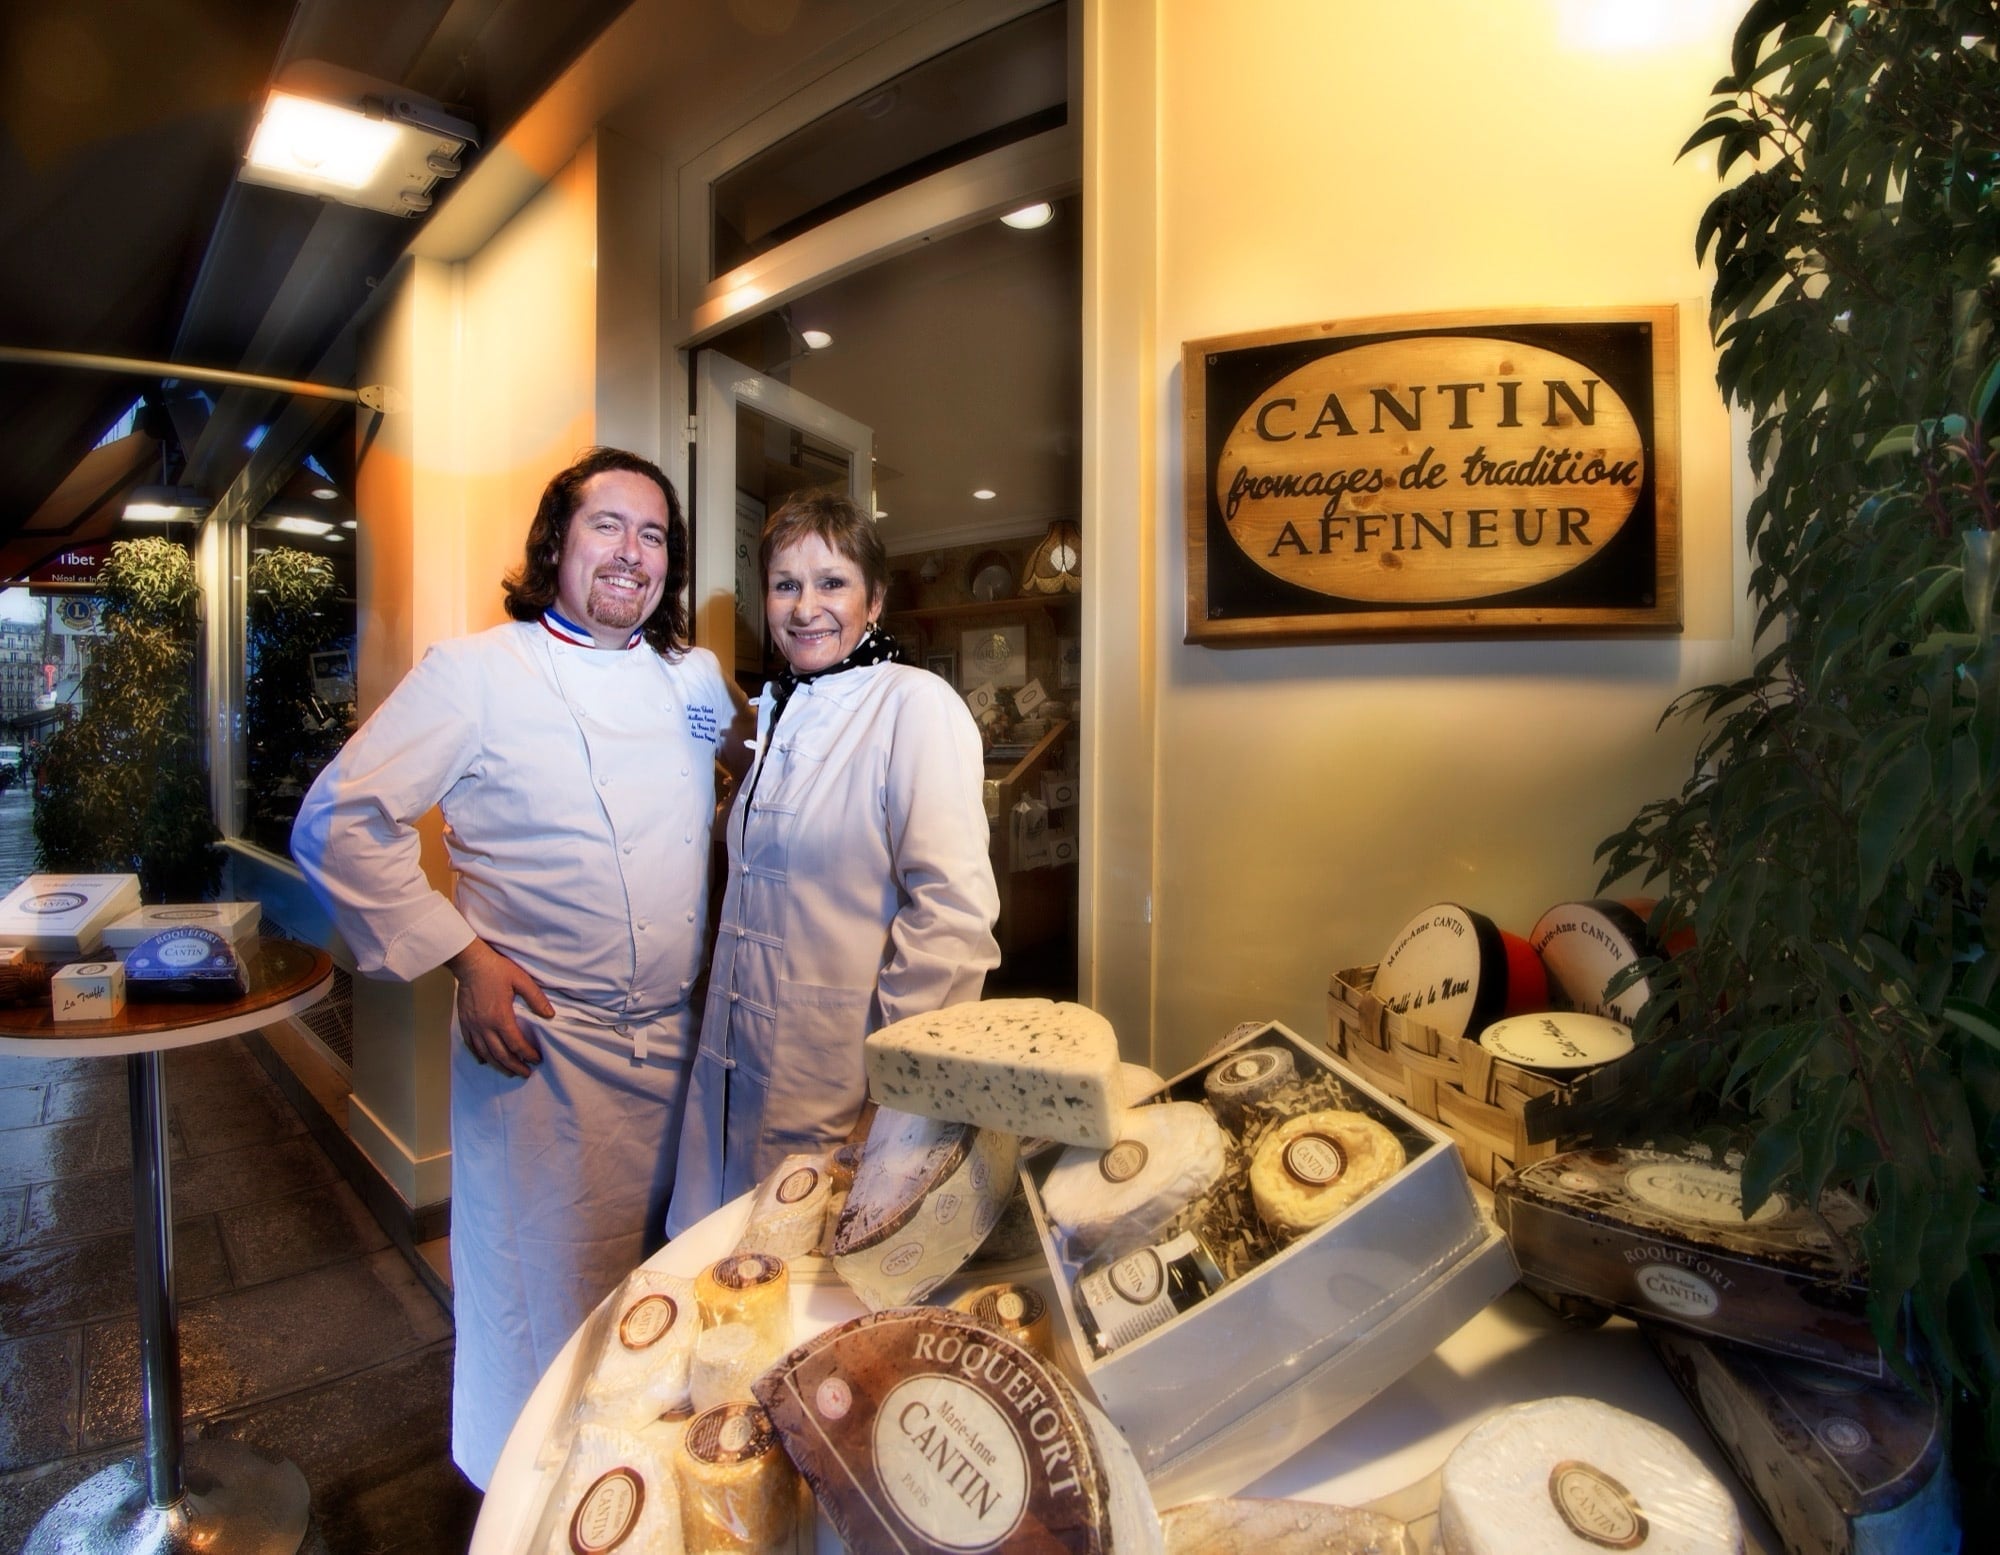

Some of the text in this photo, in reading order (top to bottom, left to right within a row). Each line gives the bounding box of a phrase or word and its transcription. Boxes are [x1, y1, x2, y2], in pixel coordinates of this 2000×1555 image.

[1255, 379, 1601, 442] CANTIN
[1226, 445, 1640, 521] fromages de tradition
[1267, 507, 1593, 558] AFFINEUR
[155, 928, 220, 945] ROQUEFORT
[164, 948, 204, 957] CANTIN
[1387, 916, 1465, 968] Marie-Anne CANTIN
[1580, 921, 1623, 961] CANTIN
[62, 999, 76, 1011] La
[1296, 1146, 1325, 1177] CANTIN
[1623, 1246, 1737, 1291] ROQUEFORT
[1645, 1276, 1710, 1305] CANTIN
[911, 1331, 1083, 1500] ROQUEFORT
[935, 1399, 999, 1469] Marie-Anne
[898, 1400, 1003, 1522] CANTIN
[591, 1488, 615, 1540] CANTIN
[900, 1472, 932, 1509] PARIS
[1569, 1486, 1616, 1534] CANTIN
